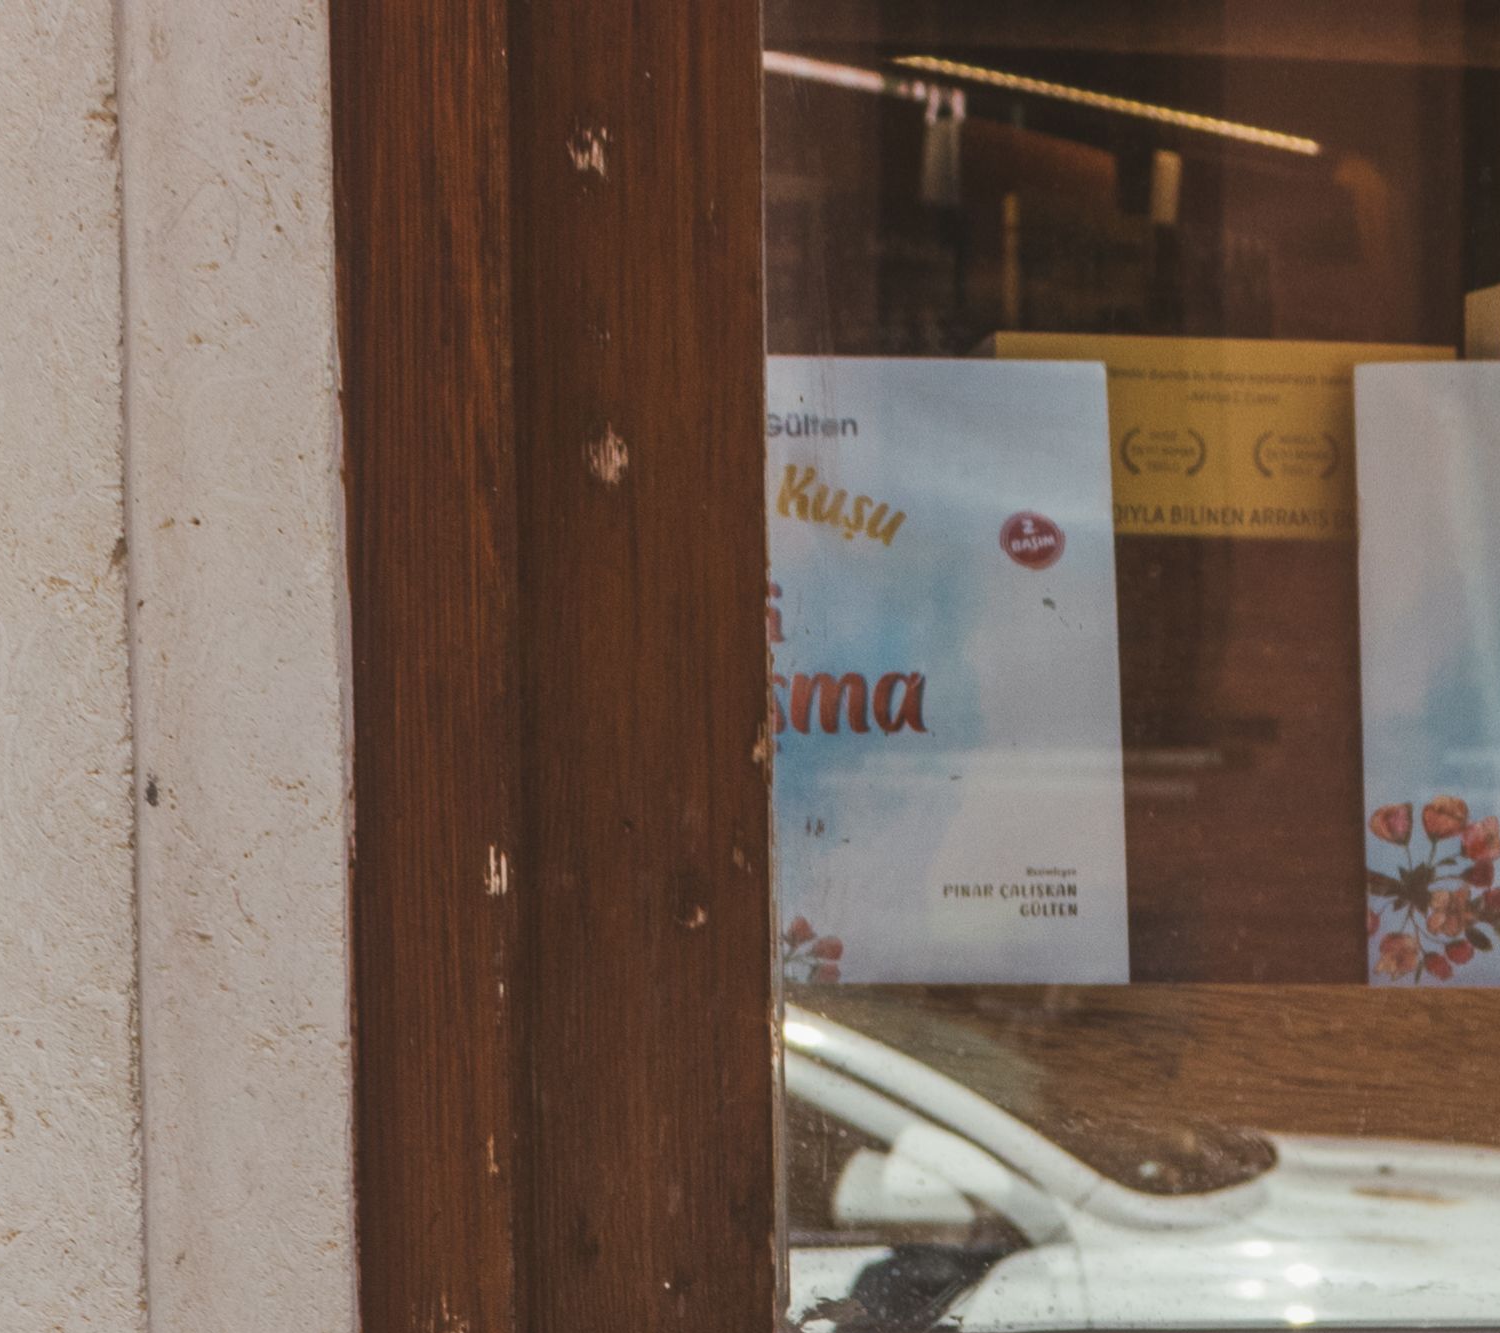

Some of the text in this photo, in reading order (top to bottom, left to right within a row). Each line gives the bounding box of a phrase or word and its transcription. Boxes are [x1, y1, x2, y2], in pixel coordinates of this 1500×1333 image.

[777, 463, 906, 547] Kuşu
[942, 883, 994, 898] PINAR
[1019, 900, 1078, 917] GÜLTEN
